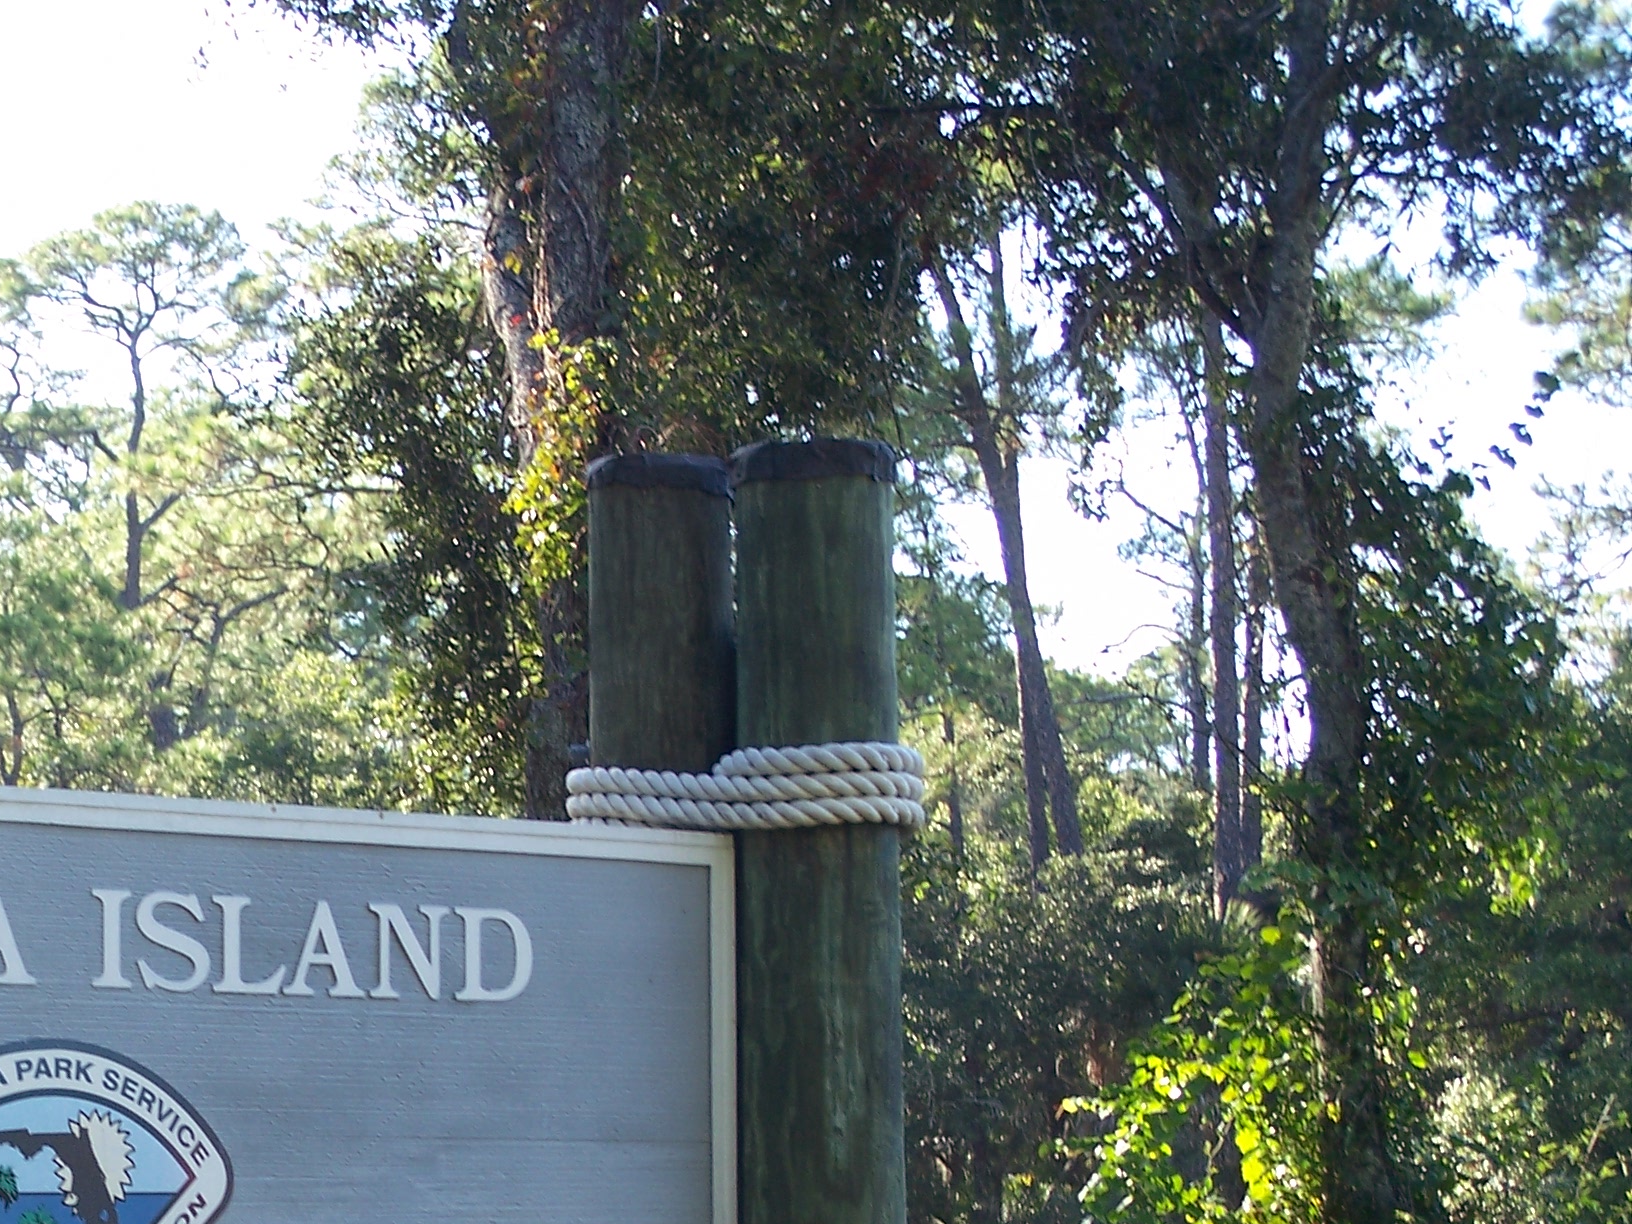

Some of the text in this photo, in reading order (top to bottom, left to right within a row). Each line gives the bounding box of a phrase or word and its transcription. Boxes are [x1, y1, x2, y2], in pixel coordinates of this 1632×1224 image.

[90, 886, 535, 1003] ISLAND
[14, 1056, 95, 1085] PARK
[101, 1069, 211, 1168] SERVICE
